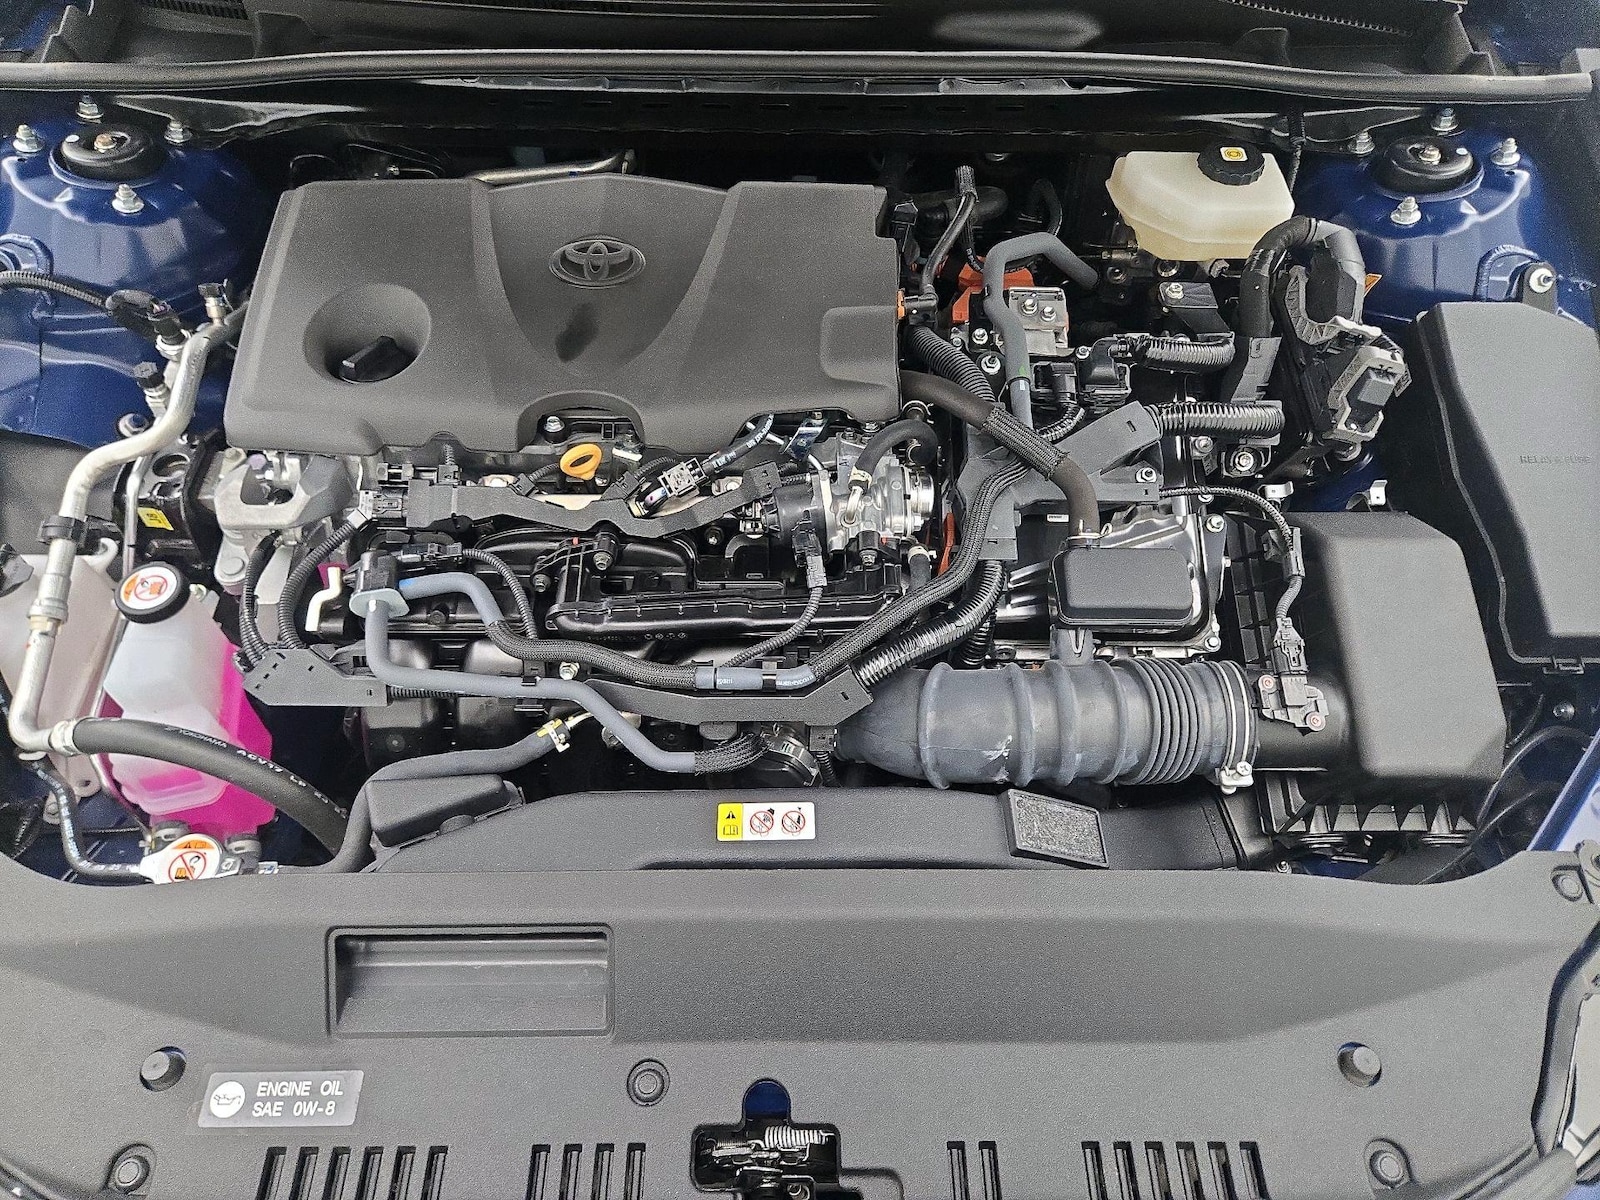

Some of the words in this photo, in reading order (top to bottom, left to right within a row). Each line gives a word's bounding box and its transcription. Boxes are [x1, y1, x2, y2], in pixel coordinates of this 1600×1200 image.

[256, 1081, 312, 1097] ENGINE
[320, 1080, 344, 1096] OIL
[251, 1101, 284, 1118] SAE
[293, 1100, 336, 1117] 0W-8
